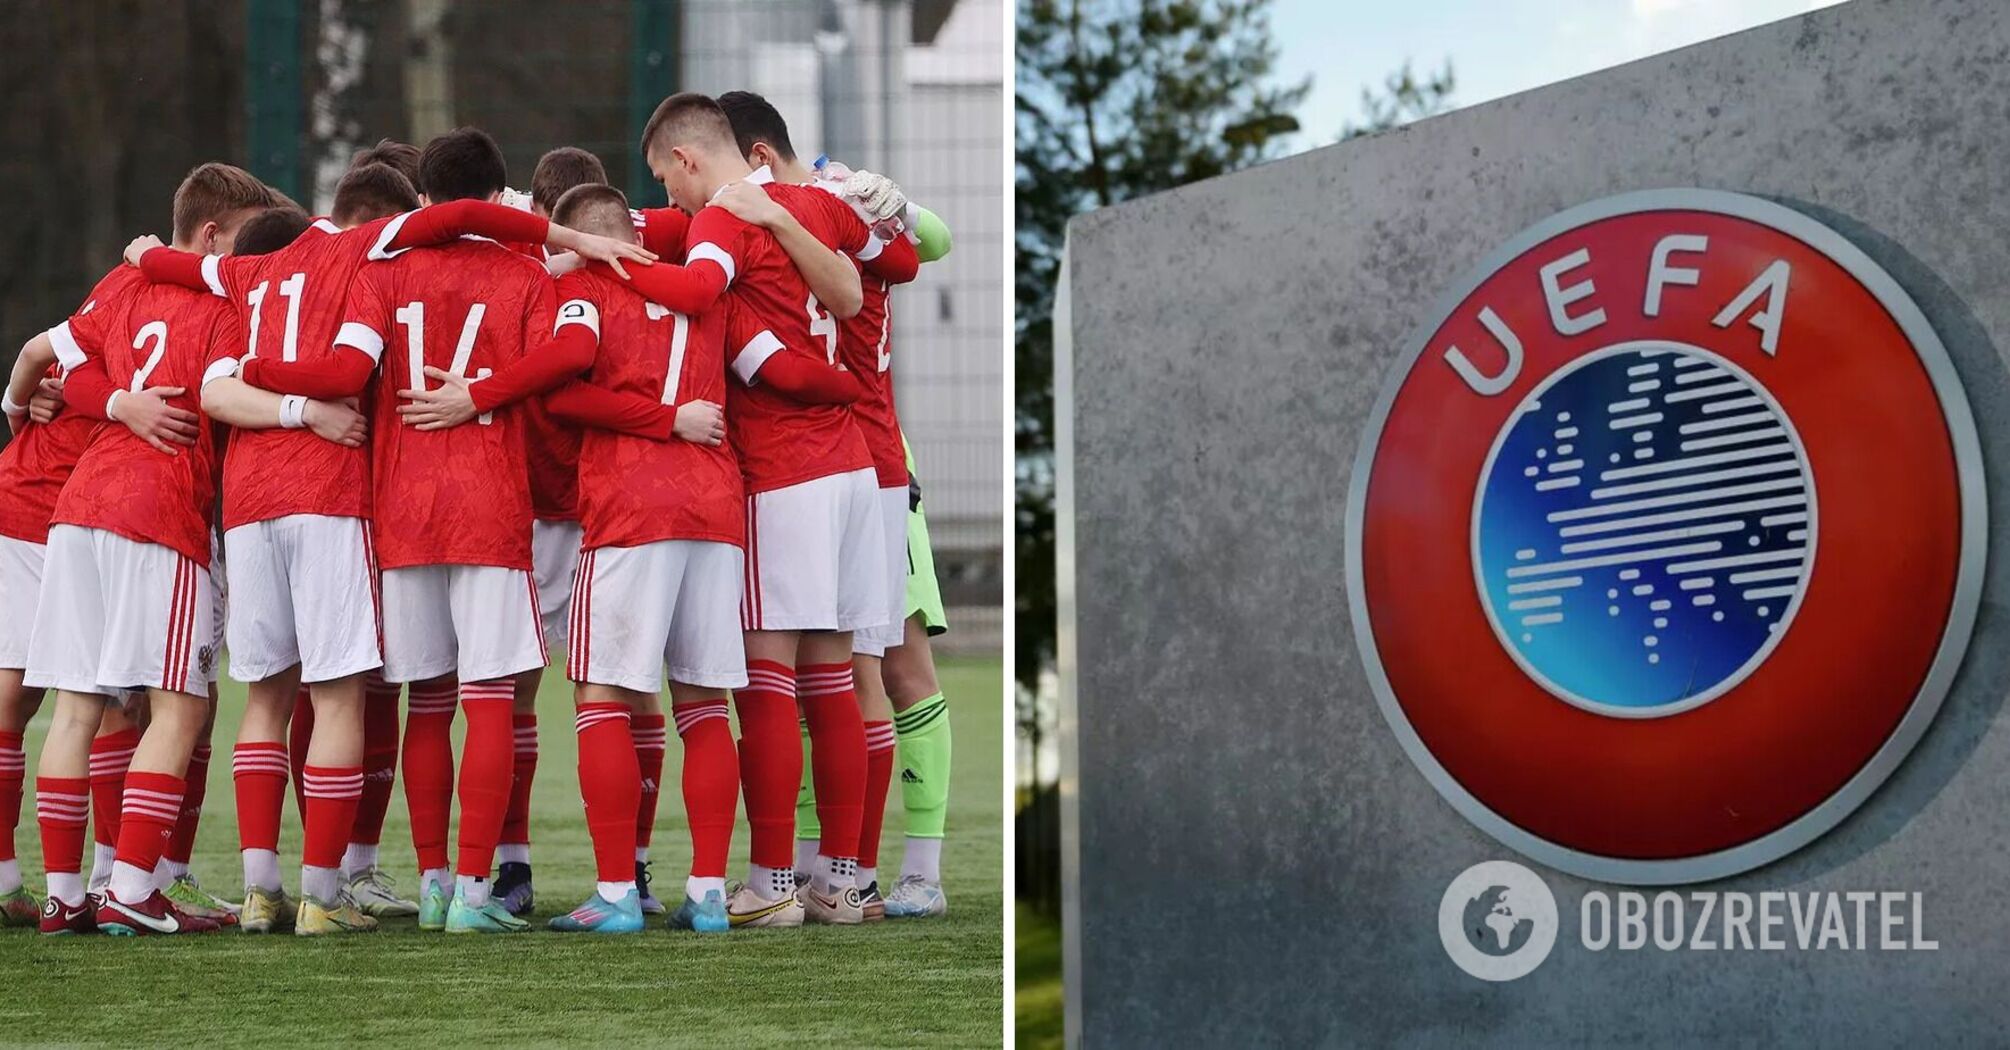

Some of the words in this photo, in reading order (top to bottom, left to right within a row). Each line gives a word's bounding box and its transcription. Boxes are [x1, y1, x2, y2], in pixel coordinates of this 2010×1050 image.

[130, 320, 168, 394] 2
[247, 272, 306, 363] 11
[396, 301, 493, 426] 14
[645, 301, 688, 406] 7
[1443, 234, 1791, 396] UEFA
